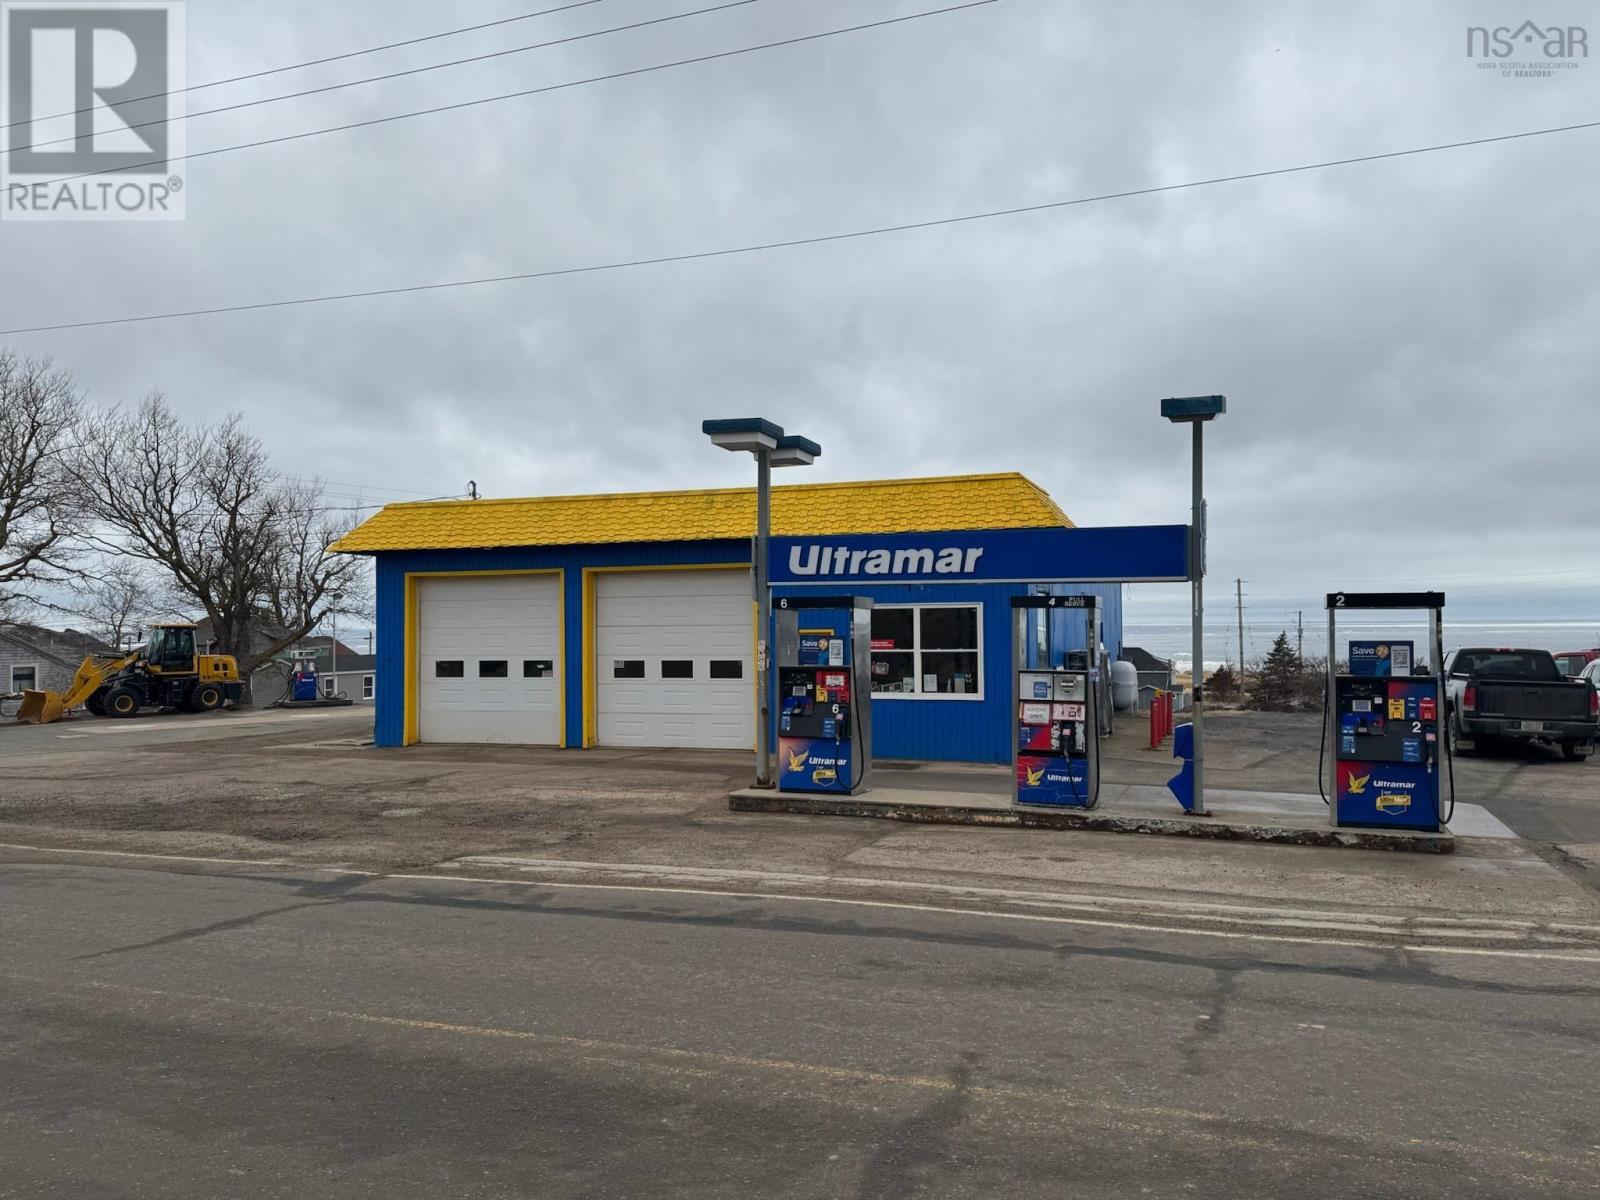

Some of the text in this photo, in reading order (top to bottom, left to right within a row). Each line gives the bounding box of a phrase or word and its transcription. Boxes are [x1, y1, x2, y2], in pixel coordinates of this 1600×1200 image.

[789, 545, 984, 576] Ultramar
[780, 598, 789, 608] 6
[1048, 597, 1056, 606] 4
[1335, 595, 1345, 606] 2
[801, 639, 818, 647] Save
[1352, 646, 1375, 655] Save
[832, 704, 840, 714] 6
[1412, 721, 1422, 733] 2
[809, 757, 848, 766] Ultramar
[1047, 774, 1083, 782] Ultramar
[1373, 780, 1416, 789] Ultramar
